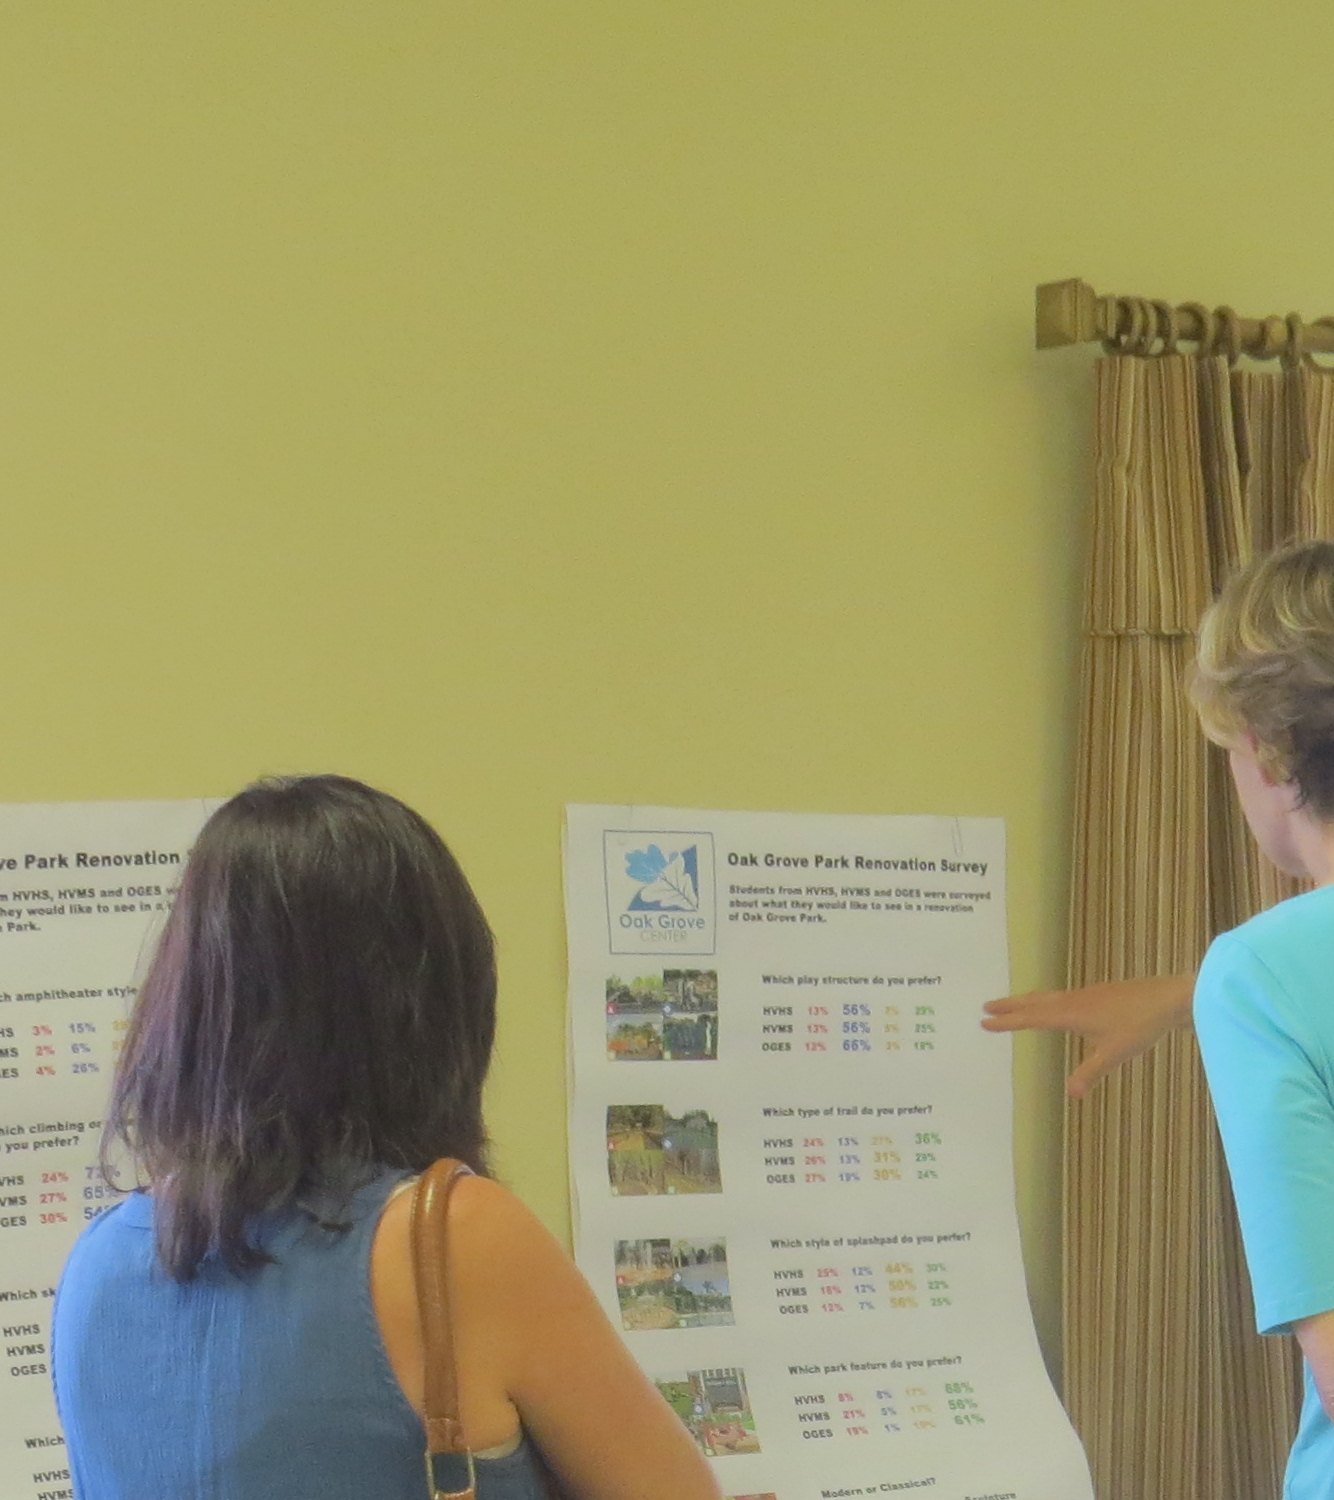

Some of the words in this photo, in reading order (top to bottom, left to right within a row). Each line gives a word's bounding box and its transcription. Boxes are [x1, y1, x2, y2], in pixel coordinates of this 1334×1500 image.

[25, 854, 68, 869] Park
[76, 852, 180, 867] Renovation
[728, 853, 758, 867] Oak
[764, 853, 808, 868] Grove
[815, 855, 848, 869] Park
[855, 856, 936, 872] Renovation
[941, 860, 988, 876] Survey
[13, 890, 53, 902] HVHS,
[58, 888, 96, 900] HVMS
[100, 887, 123, 898] and
[127, 886, 161, 896] OGES
[729, 885, 775, 895] Students
[779, 886, 802, 896] from
[874, 888, 891, 898] and
[949, 892, 991, 901] surveyed
[27, 905, 65, 916] would
[69, 903, 91, 915] like
[97, 904, 109, 914] to
[114, 903, 134, 913] see
[140, 901, 152, 912] in
[156, 903, 164, 911] a
[729, 900, 758, 909] about
[762, 901, 787, 909] what
[791, 901, 812, 911] they
[817, 901, 846, 910] would
[850, 902, 868, 910] like
[872, 902, 881, 910] to
[905, 903, 913, 911] in
[924, 903, 973, 912] renovation
[620, 914, 653, 928] Oak
[658, 914, 705, 928] Grove
[743, 913, 762, 922] Oak
[767, 914, 796, 923] Grove
[800, 914, 826, 923] Park.
[7, 921, 42, 933] Park.
[641, 930, 687, 942] CENTER
[762, 975, 794, 985] Which
[798, 976, 818, 986] play
[822, 976, 868, 985] structure
[873, 976, 884, 984] do
[888, 977, 905, 987] you
[908, 976, 942, 986] prefer?
[16, 988, 103, 1002] amphitheater
[107, 985, 137, 997] style
[763, 1006, 793, 1016] HVHS
[843, 1004, 870, 1015] 56%
[32, 1025, 52, 1036] 3%
[69, 1023, 96, 1034] 15%
[763, 1024, 793, 1033] HVMS
[843, 1022, 870, 1033] 56%
[35, 1045, 55, 1056] 2%
[71, 1043, 91, 1054] 6%
[762, 1042, 791, 1051] OGES
[843, 1039, 871, 1051] 66%
[36, 1066, 56, 1076] 4%
[72, 1063, 99, 1074] 26%
[763, 1108, 795, 1117] Which
[798, 1108, 819, 1118] type
[823, 1107, 833, 1116] of
[837, 1106, 857, 1115] trail
[861, 1107, 873, 1115] do
[877, 1108, 894, 1117] you
[897, 1105, 932, 1116] prefer?
[29, 1121, 84, 1132] climbing
[6, 1142, 28, 1153] you
[33, 1136, 80, 1151] prefer?
[764, 1138, 793, 1148] HVHS
[765, 1156, 795, 1166] HVMS
[42, 1172, 69, 1183] 24%
[767, 1174, 795, 1184] OGES
[40, 1193, 67, 1204] 27%
[771, 1239, 801, 1248] Which
[806, 1239, 829, 1249] style
[834, 1238, 843, 1246] of
[847, 1237, 897, 1248] splashpad
[901, 1235, 913, 1244] do
[917, 1236, 933, 1245] you
[774, 1270, 803, 1280] HVHS
[776, 1287, 806, 1297] HVMS
[779, 1305, 808, 1315] OGES
[3, 1324, 40, 1337] HVHS
[7, 1344, 45, 1357] HVMS
[11, 1364, 47, 1376] OGES
[789, 1365, 820, 1375] Which
[824, 1364, 847, 1375] park
[851, 1362, 886, 1371] feature
[890, 1360, 902, 1369] do
[906, 1360, 923, 1370] you
[927, 1356, 962, 1368] prefer?
[795, 1395, 825, 1405] HVHS
[798, 1412, 830, 1422] HVMS
[803, 1429, 833, 1439] OGES
[25, 1435, 66, 1448] Which
[33, 1469, 70, 1483] HVHS
[822, 1487, 863, 1499] Modern
[866, 1486, 877, 1494] or
[880, 1477, 936, 1493] Classical?
